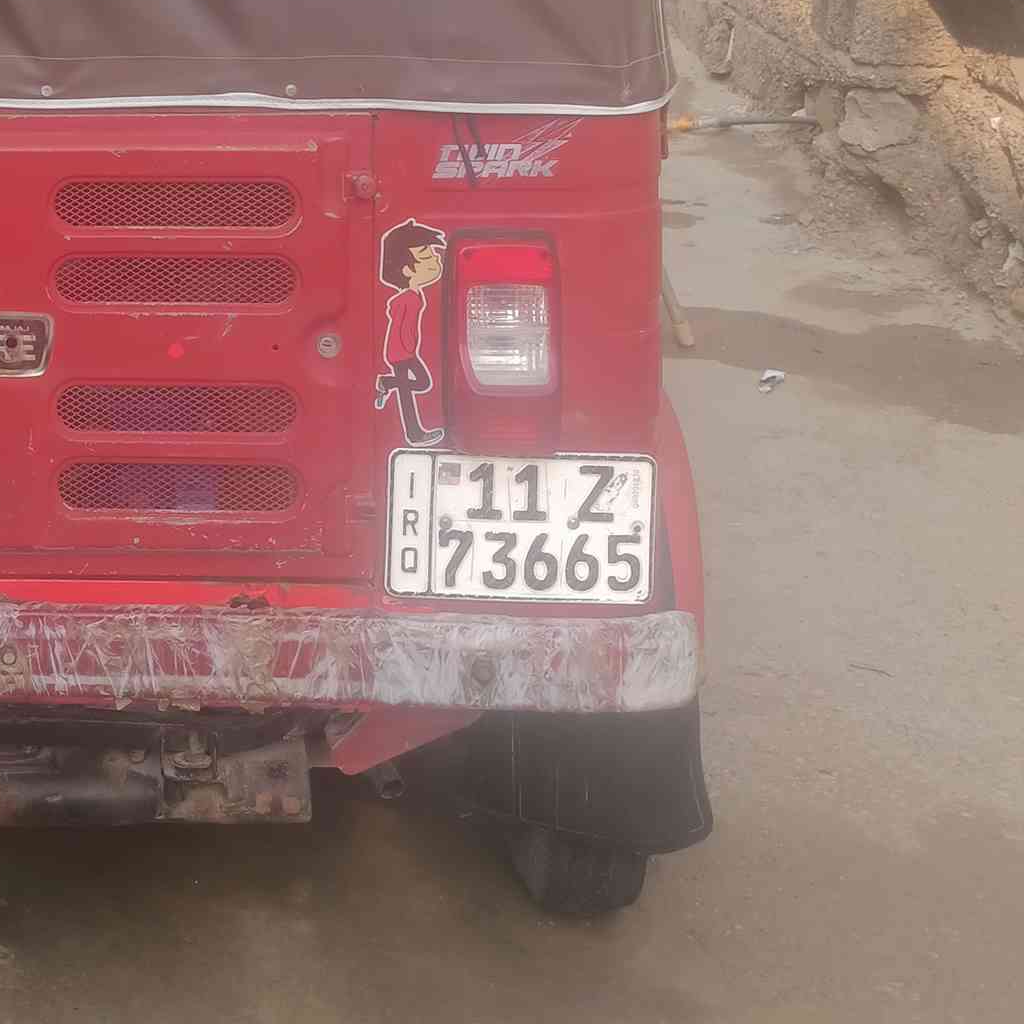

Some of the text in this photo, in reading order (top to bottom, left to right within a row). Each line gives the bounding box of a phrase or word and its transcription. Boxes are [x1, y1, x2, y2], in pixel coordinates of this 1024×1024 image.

[432, 159, 560, 179] SPARK
[401, 471, 419, 574] IRQ
[467, 462, 547, 521] 11
[576, 465, 616, 523] Z
[439, 529, 642, 592] 73665
